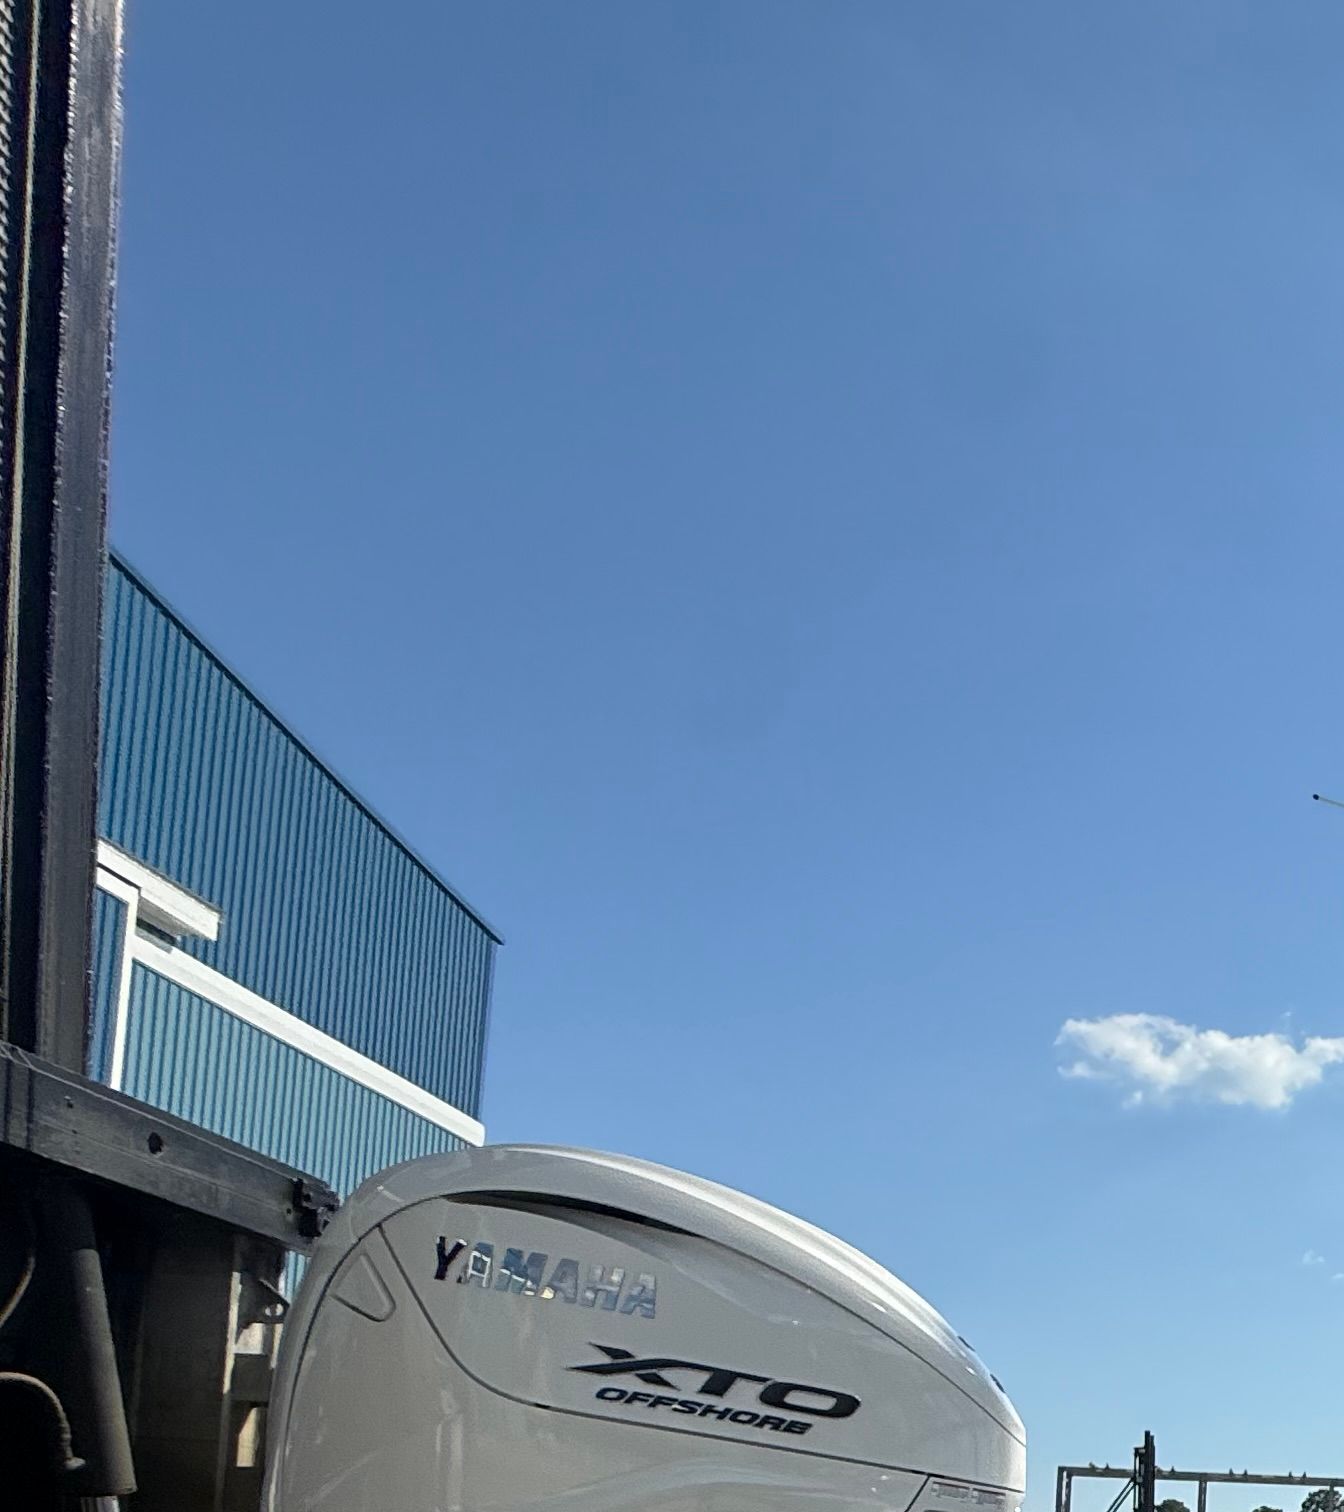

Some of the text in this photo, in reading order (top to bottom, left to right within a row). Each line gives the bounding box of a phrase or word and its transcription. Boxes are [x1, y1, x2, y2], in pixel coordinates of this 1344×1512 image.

[434, 1235, 657, 1320] YAMAHA
[564, 1342, 862, 1418] XTO
[595, 1386, 814, 1435] OFFSHORE
